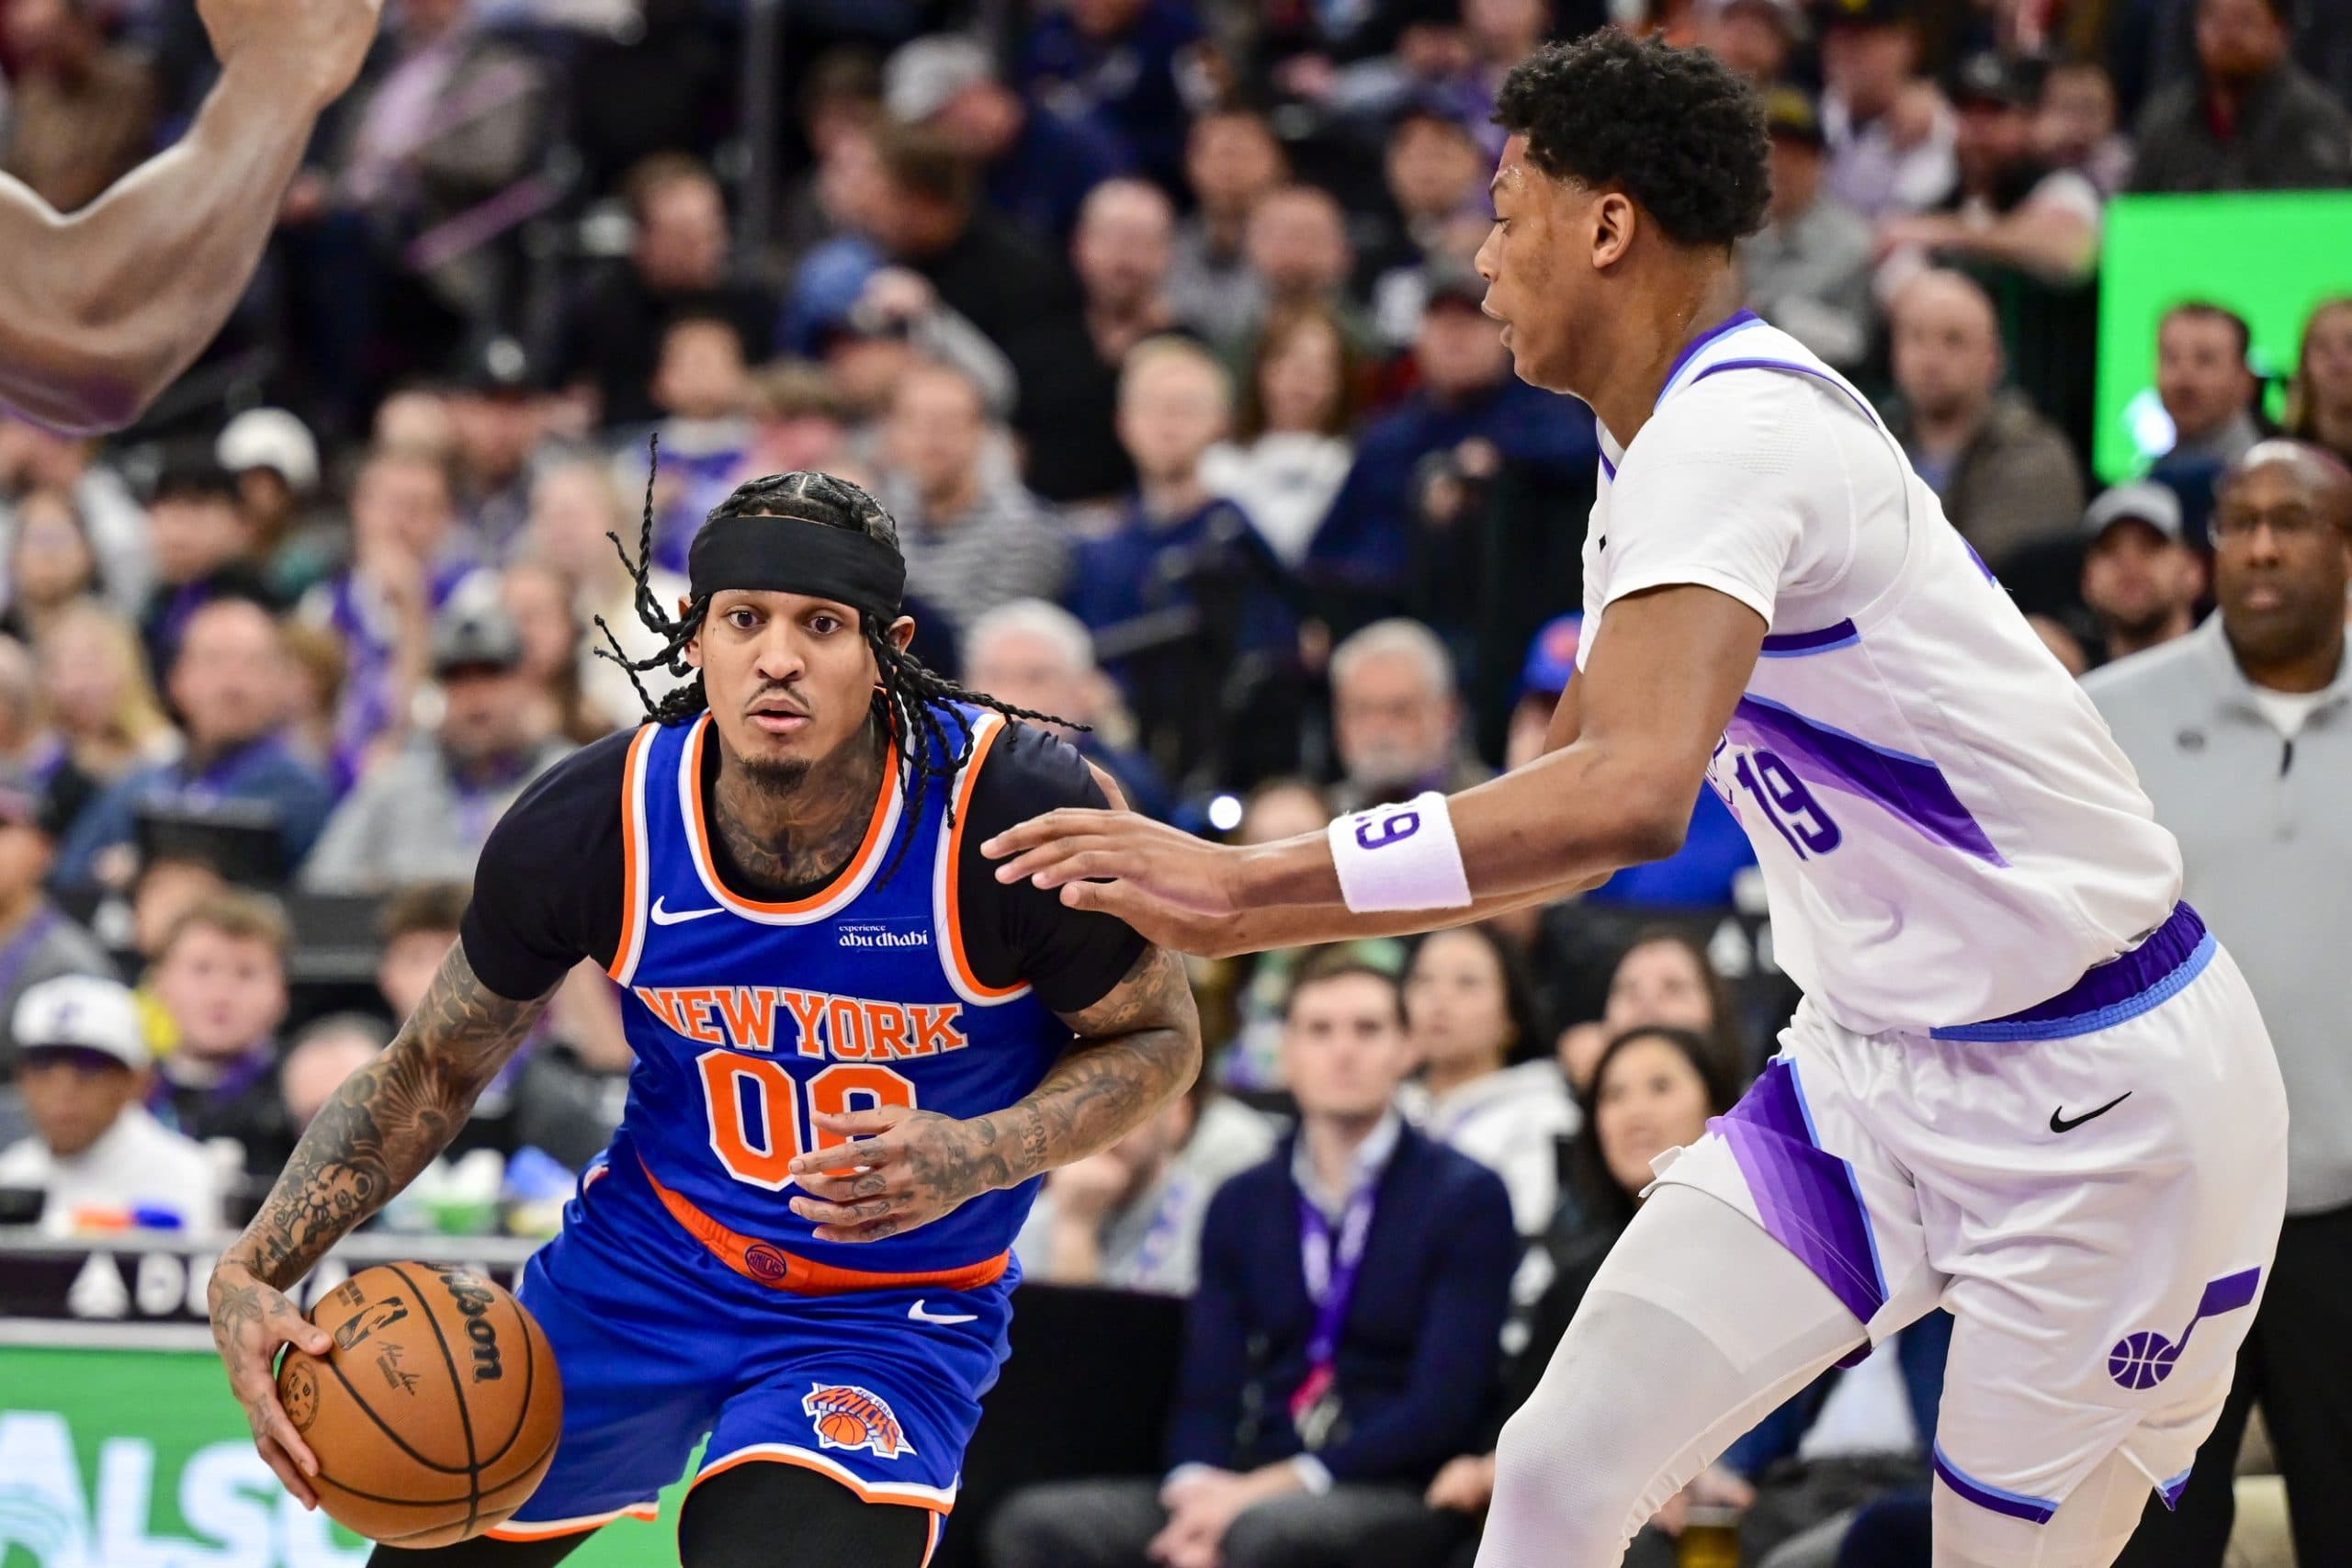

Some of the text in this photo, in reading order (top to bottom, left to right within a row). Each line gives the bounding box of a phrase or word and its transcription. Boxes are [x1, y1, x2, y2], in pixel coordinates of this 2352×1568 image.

[1735, 749, 1842, 862] 19
[838, 924, 887, 933] experience
[838, 929, 929, 947] abu dhabi
[631, 985, 968, 1063] NEW YORK
[806, 1387, 900, 1456] KNICKS
